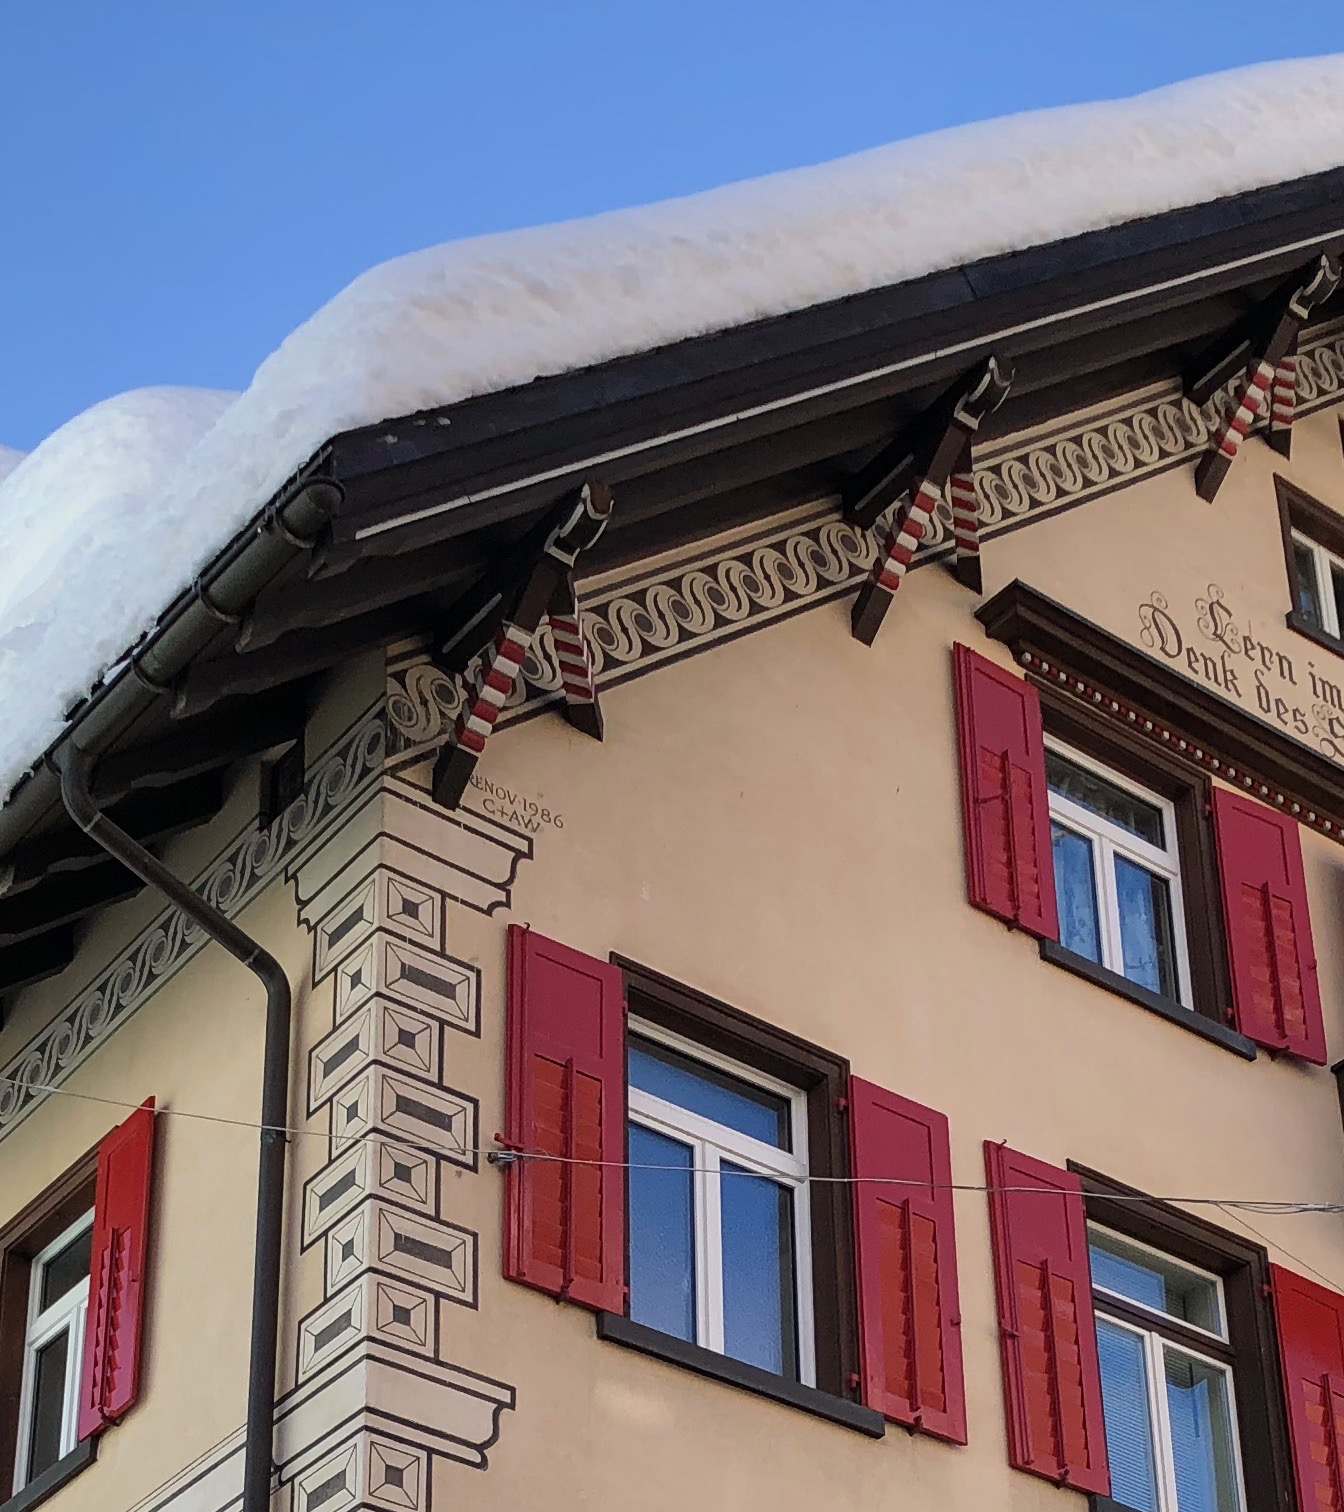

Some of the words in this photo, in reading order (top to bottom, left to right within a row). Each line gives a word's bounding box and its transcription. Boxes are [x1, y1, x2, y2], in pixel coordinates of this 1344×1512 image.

[1138, 590, 1243, 699] Denk
[1254, 668, 1309, 736] des
[1194, 583, 1298, 686] Lern
[523, 798, 564, 829] 1986
